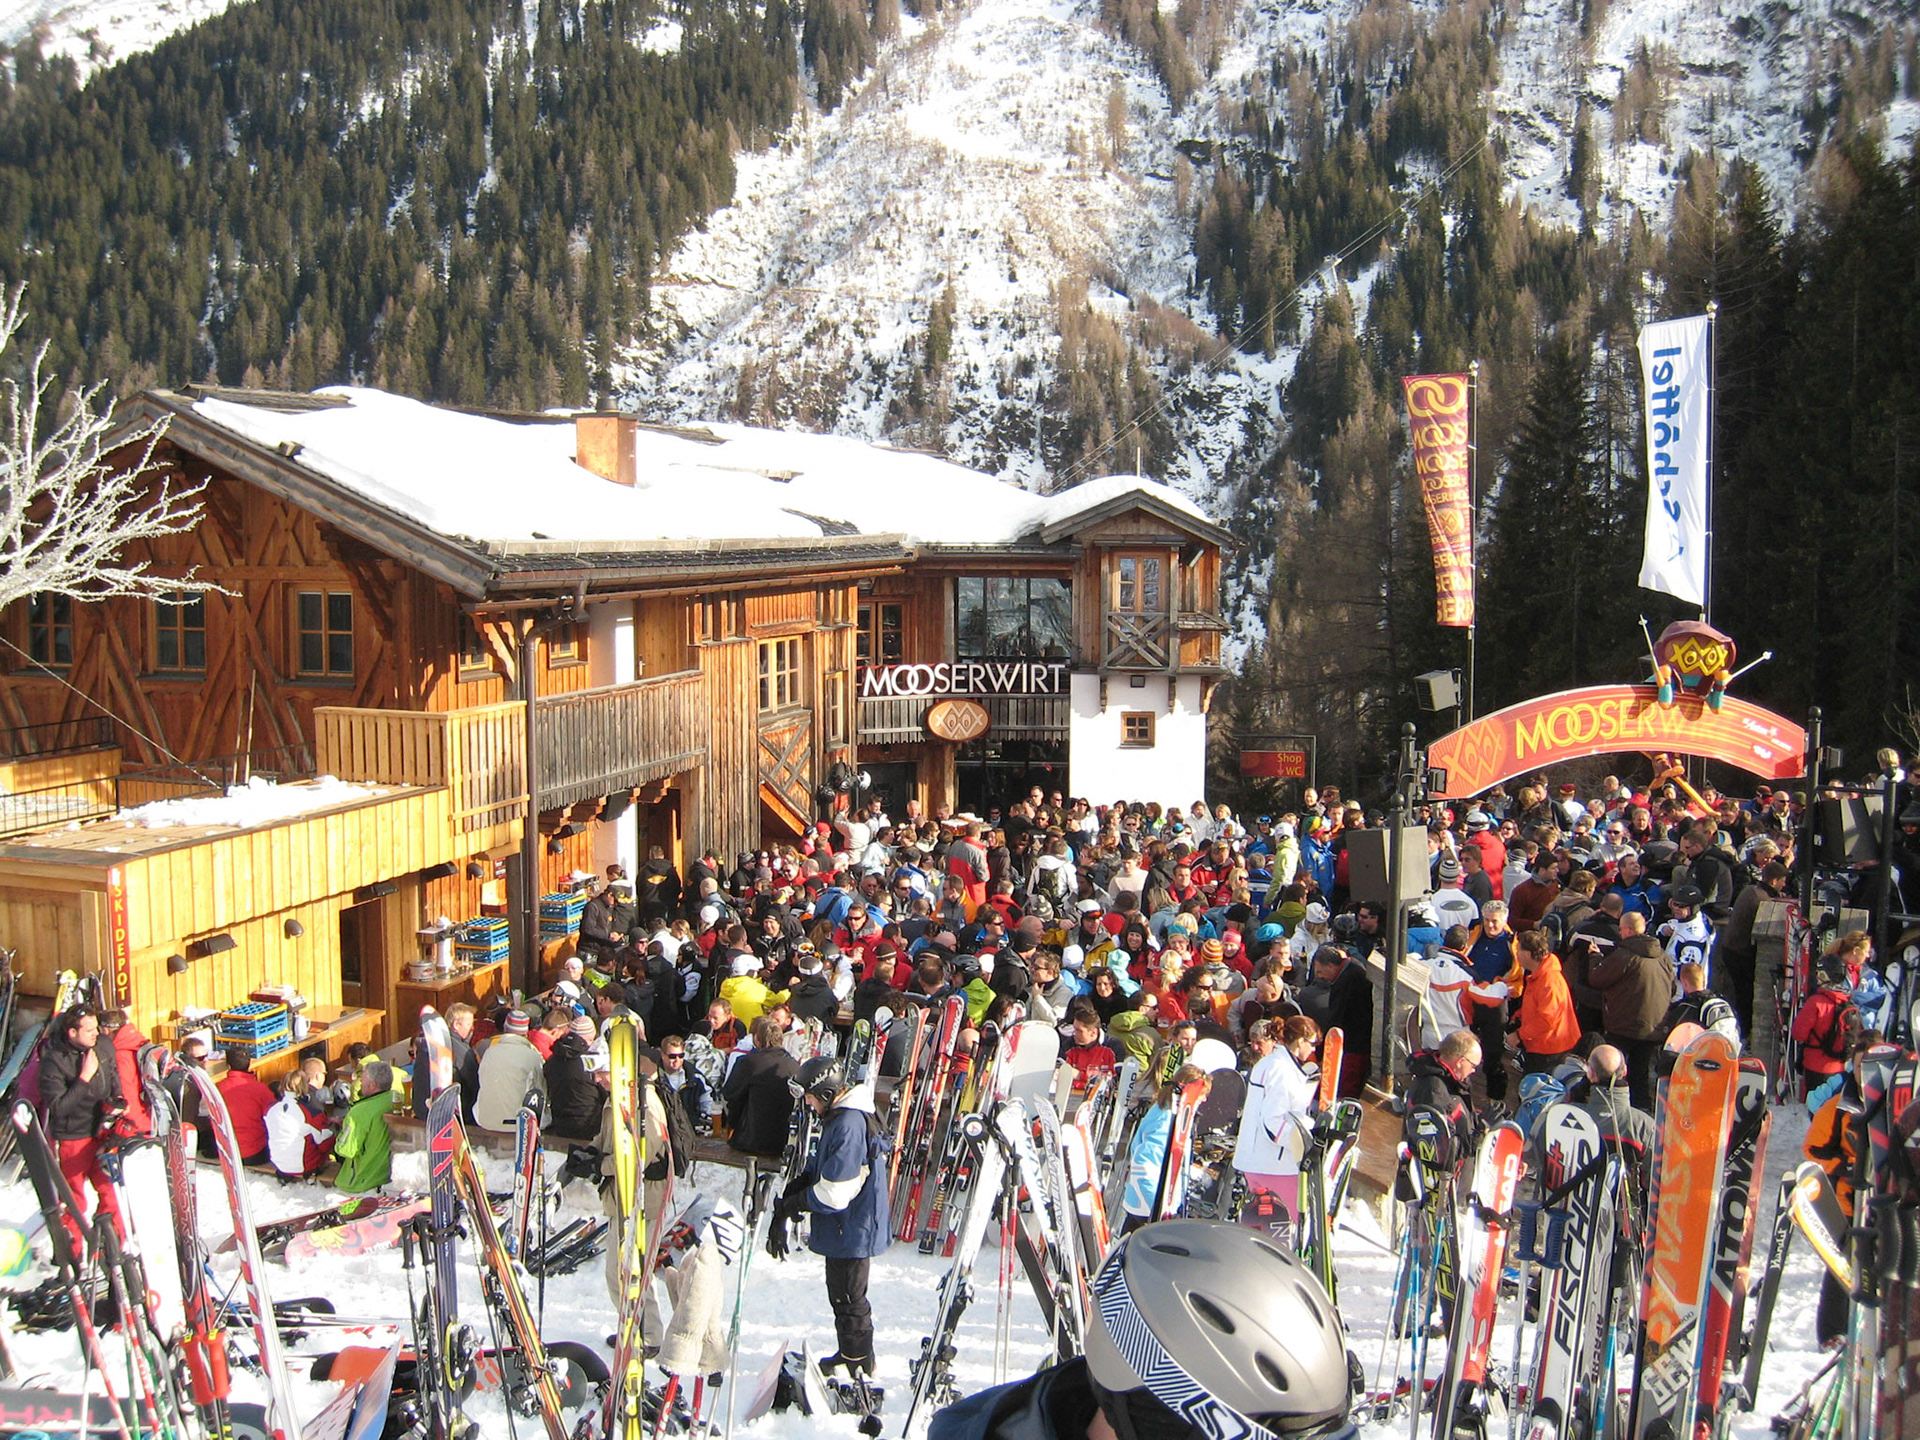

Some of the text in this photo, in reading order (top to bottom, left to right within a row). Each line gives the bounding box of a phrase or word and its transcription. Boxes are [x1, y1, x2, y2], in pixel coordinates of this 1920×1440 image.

[863, 663, 1066, 697] MOOSERWIRT
[1277, 753, 1302, 765] Shop
[1285, 766, 1302, 776] WC
[1124, 1072, 1138, 1108] HEAD
[1554, 1138, 1594, 1357] FISCHER
[1591, 1312, 1605, 1383] APACHE
